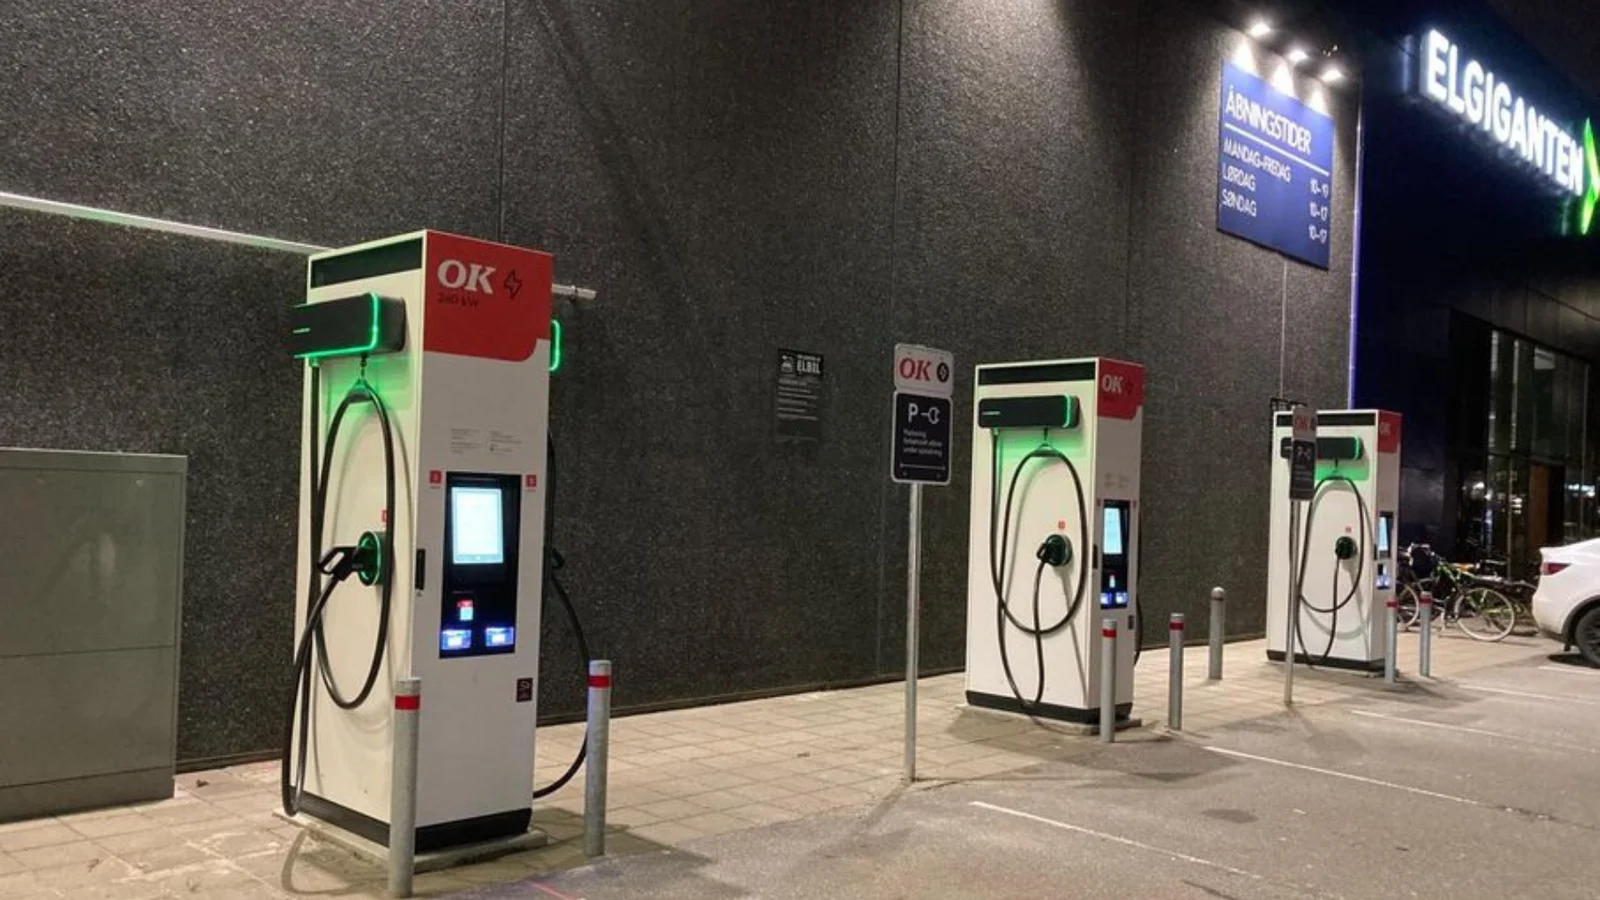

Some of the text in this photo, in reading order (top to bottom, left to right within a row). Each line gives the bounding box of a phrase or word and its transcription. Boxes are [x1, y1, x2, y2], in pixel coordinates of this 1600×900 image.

[1225, 84, 1312, 156] ÅBNINGSTIDER
[1422, 29, 1584, 196] ELGIGANTEN
[1223, 136, 1292, 183] MANDAG-FREDAG
[1222, 162, 1256, 192] LØRDAG
[1221, 188, 1257, 218] SØNDAG
[437, 259, 497, 295] OK
[900, 358, 932, 382] OK
[1102, 374, 1125, 394] OK
[908, 403, 918, 423] P
